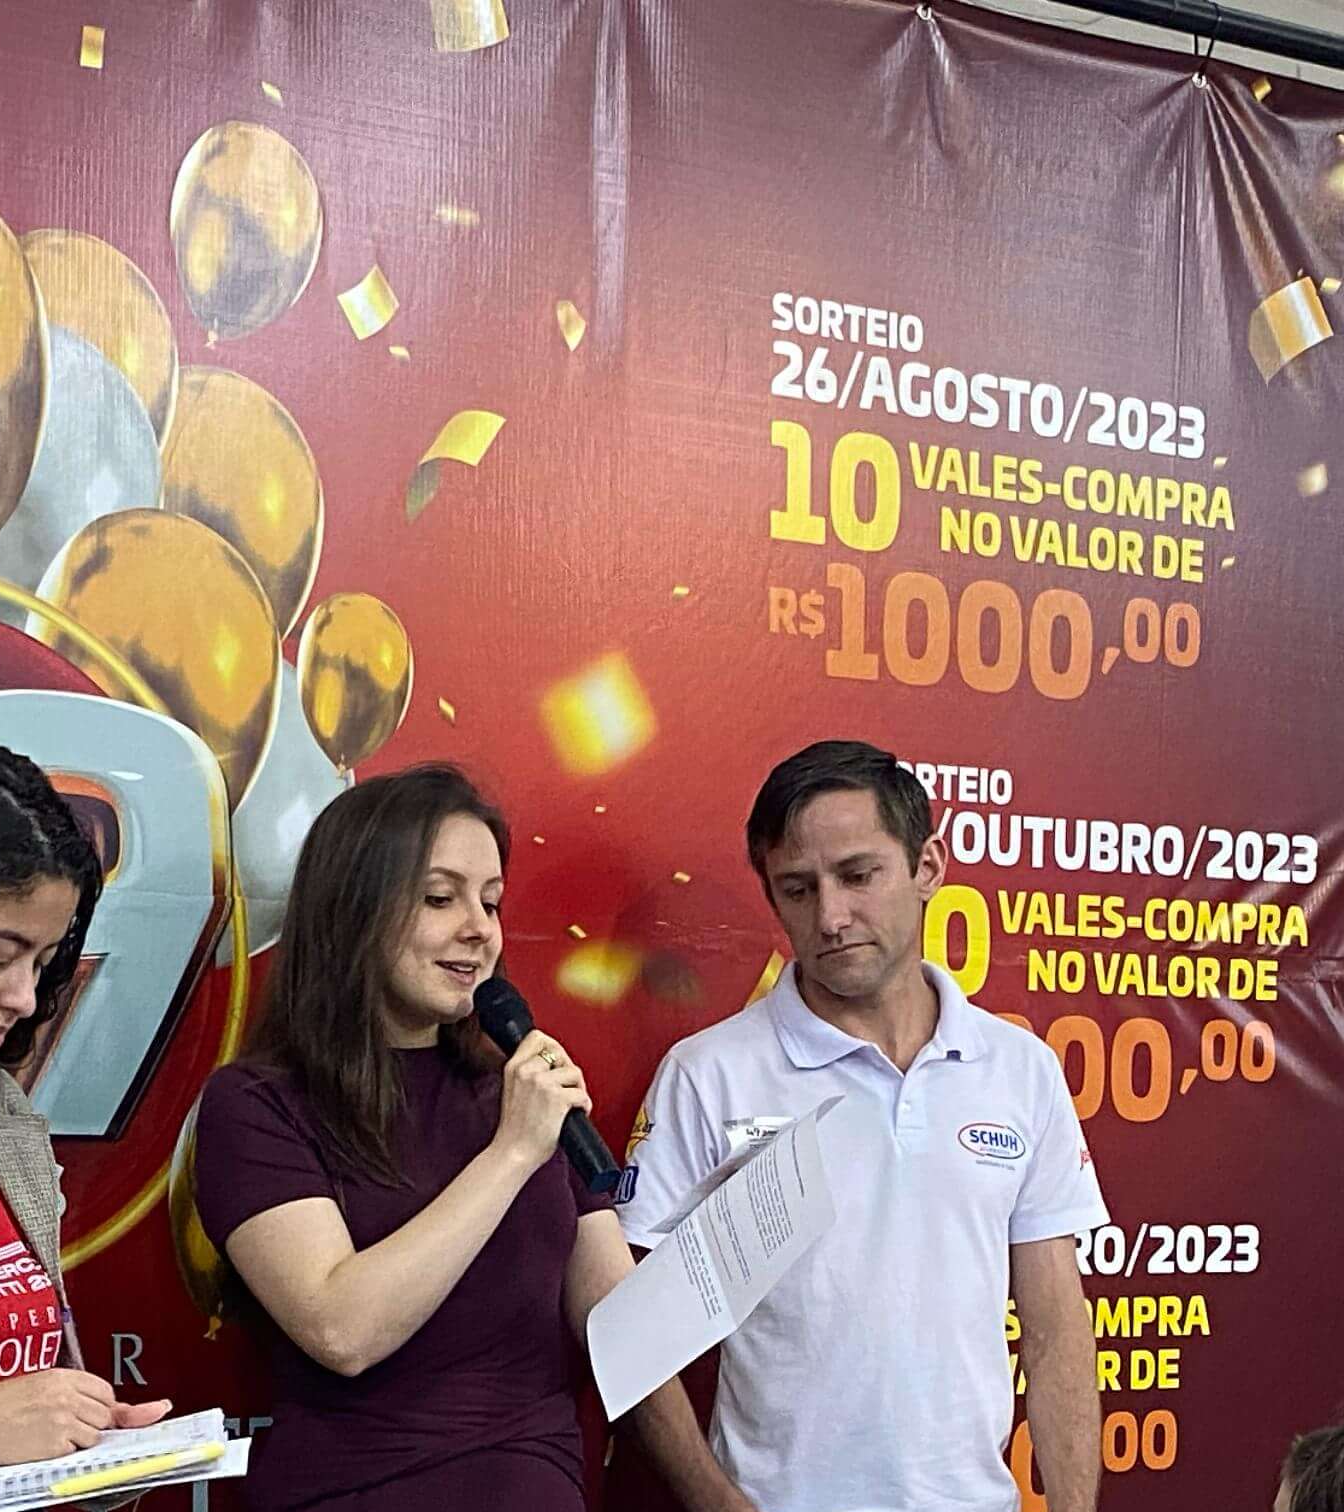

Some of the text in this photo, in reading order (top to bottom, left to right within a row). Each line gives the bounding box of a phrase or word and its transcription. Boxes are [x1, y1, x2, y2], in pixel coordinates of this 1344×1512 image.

[771, 292, 924, 353] SORTEIO
[770, 341, 1206, 459] 26/AGOSTO/2023
[770, 420, 902, 552] 10
[909, 441, 1236, 531] VALES-COMPRA
[940, 507, 1205, 583] NO VALOR DE
[896, 761, 1013, 806] RTEIO
[997, 890, 1308, 948] VALES-COMPRA
[1028, 949, 1278, 1001] NO VALOR DE
[969, 1130, 1018, 1151] SCHUH
[1130, 1349, 1181, 1390] DE
